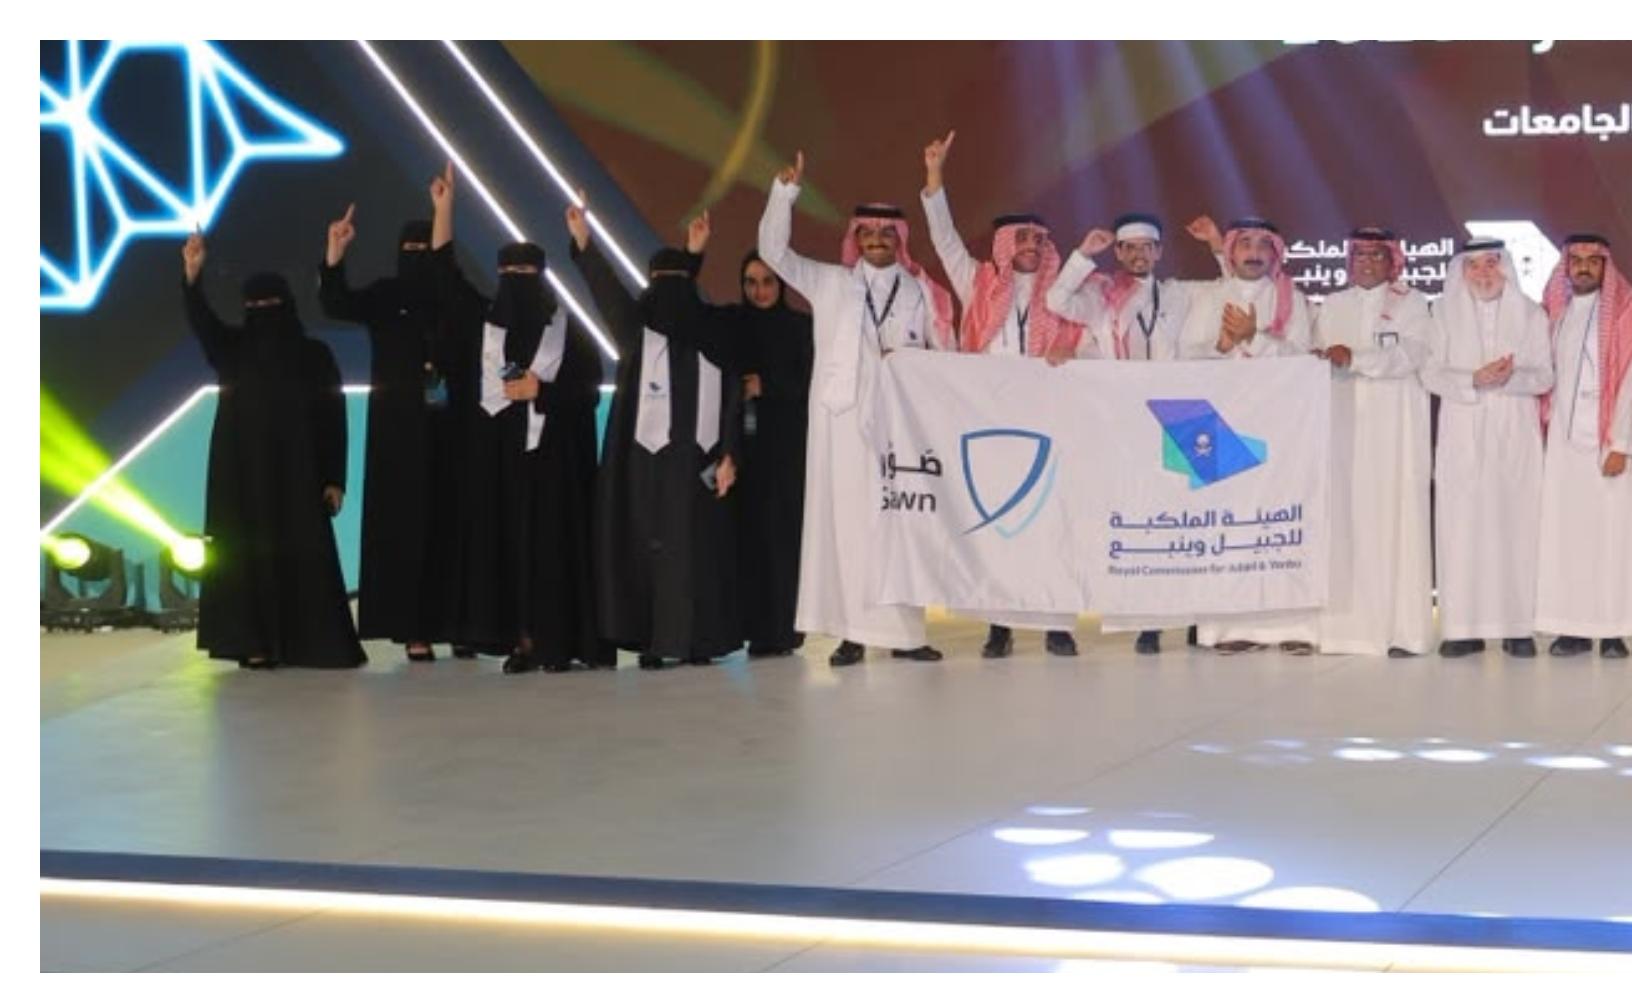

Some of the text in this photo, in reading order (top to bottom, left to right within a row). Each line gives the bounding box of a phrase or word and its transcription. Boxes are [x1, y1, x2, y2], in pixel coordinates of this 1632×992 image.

[1109, 508, 1216, 534] الملكية
[1108, 528, 1302, 559] للجبيل وينبع
